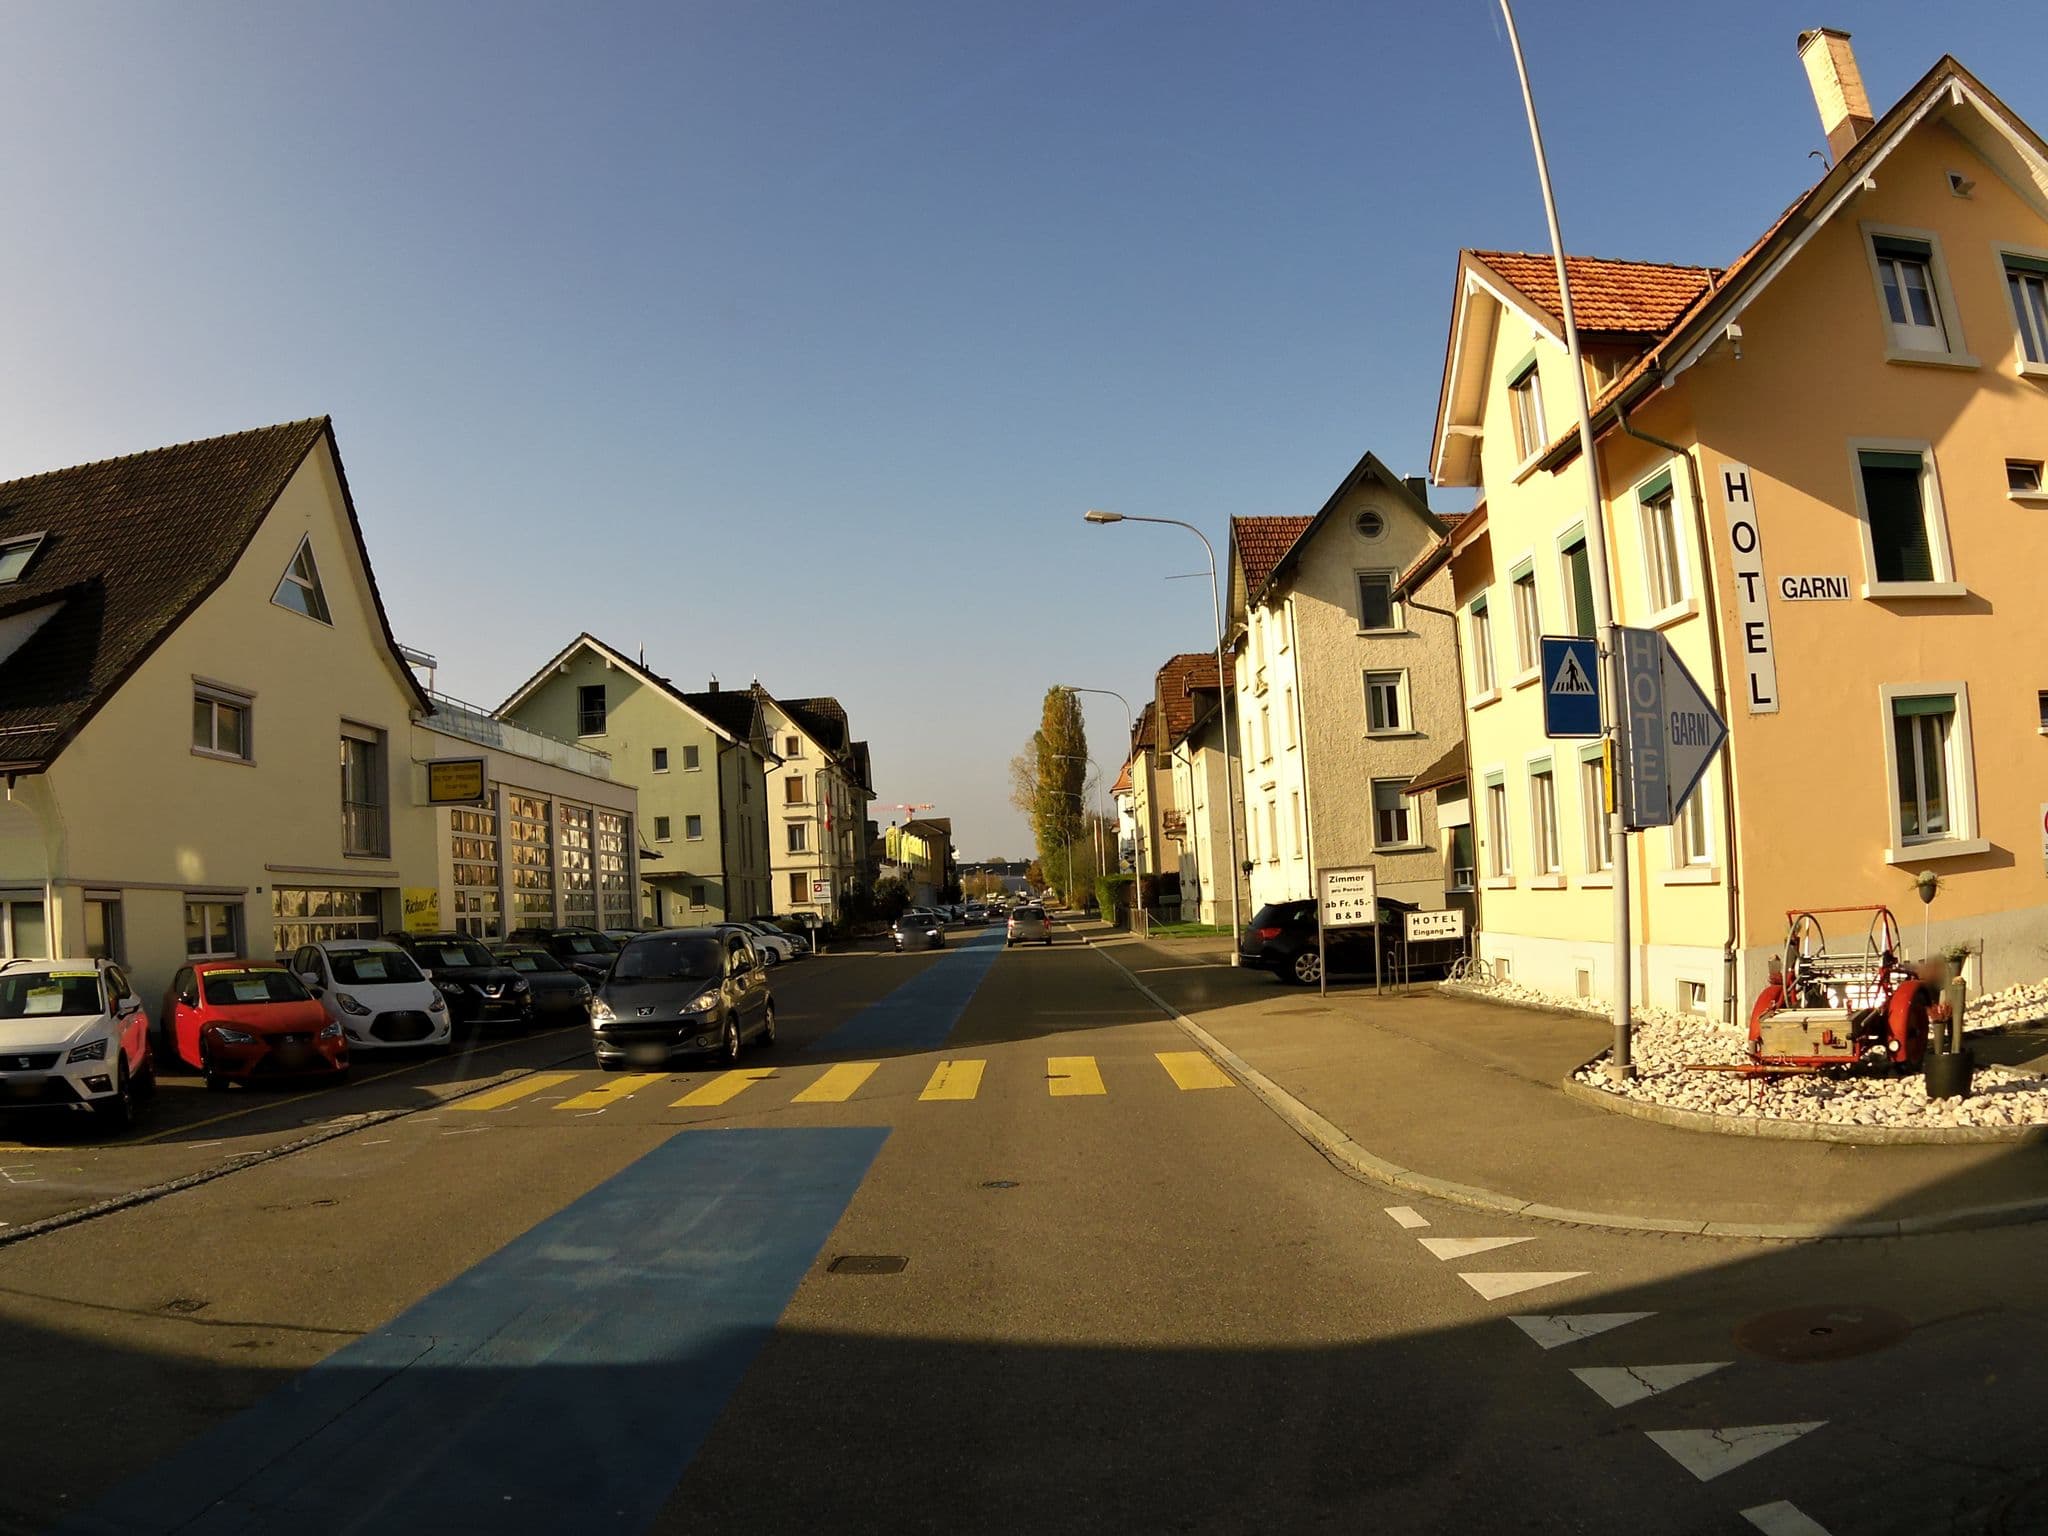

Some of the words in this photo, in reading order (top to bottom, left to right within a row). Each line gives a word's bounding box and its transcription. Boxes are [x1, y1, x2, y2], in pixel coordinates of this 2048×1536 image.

[1725, 472, 1771, 704] HOTEL
[1781, 577, 1849, 599] GARNI
[1631, 634, 1660, 819] HOTEL
[1670, 711, 1711, 746] GARNI
[1329, 875, 1365, 884] Zimmer
[1325, 900, 1337, 908] ab
[1335, 912, 1342, 920] B
[1355, 911, 1362, 919] B
[1413, 915, 1457, 925] HOTEL
[1413, 928, 1444, 936] Eingang
